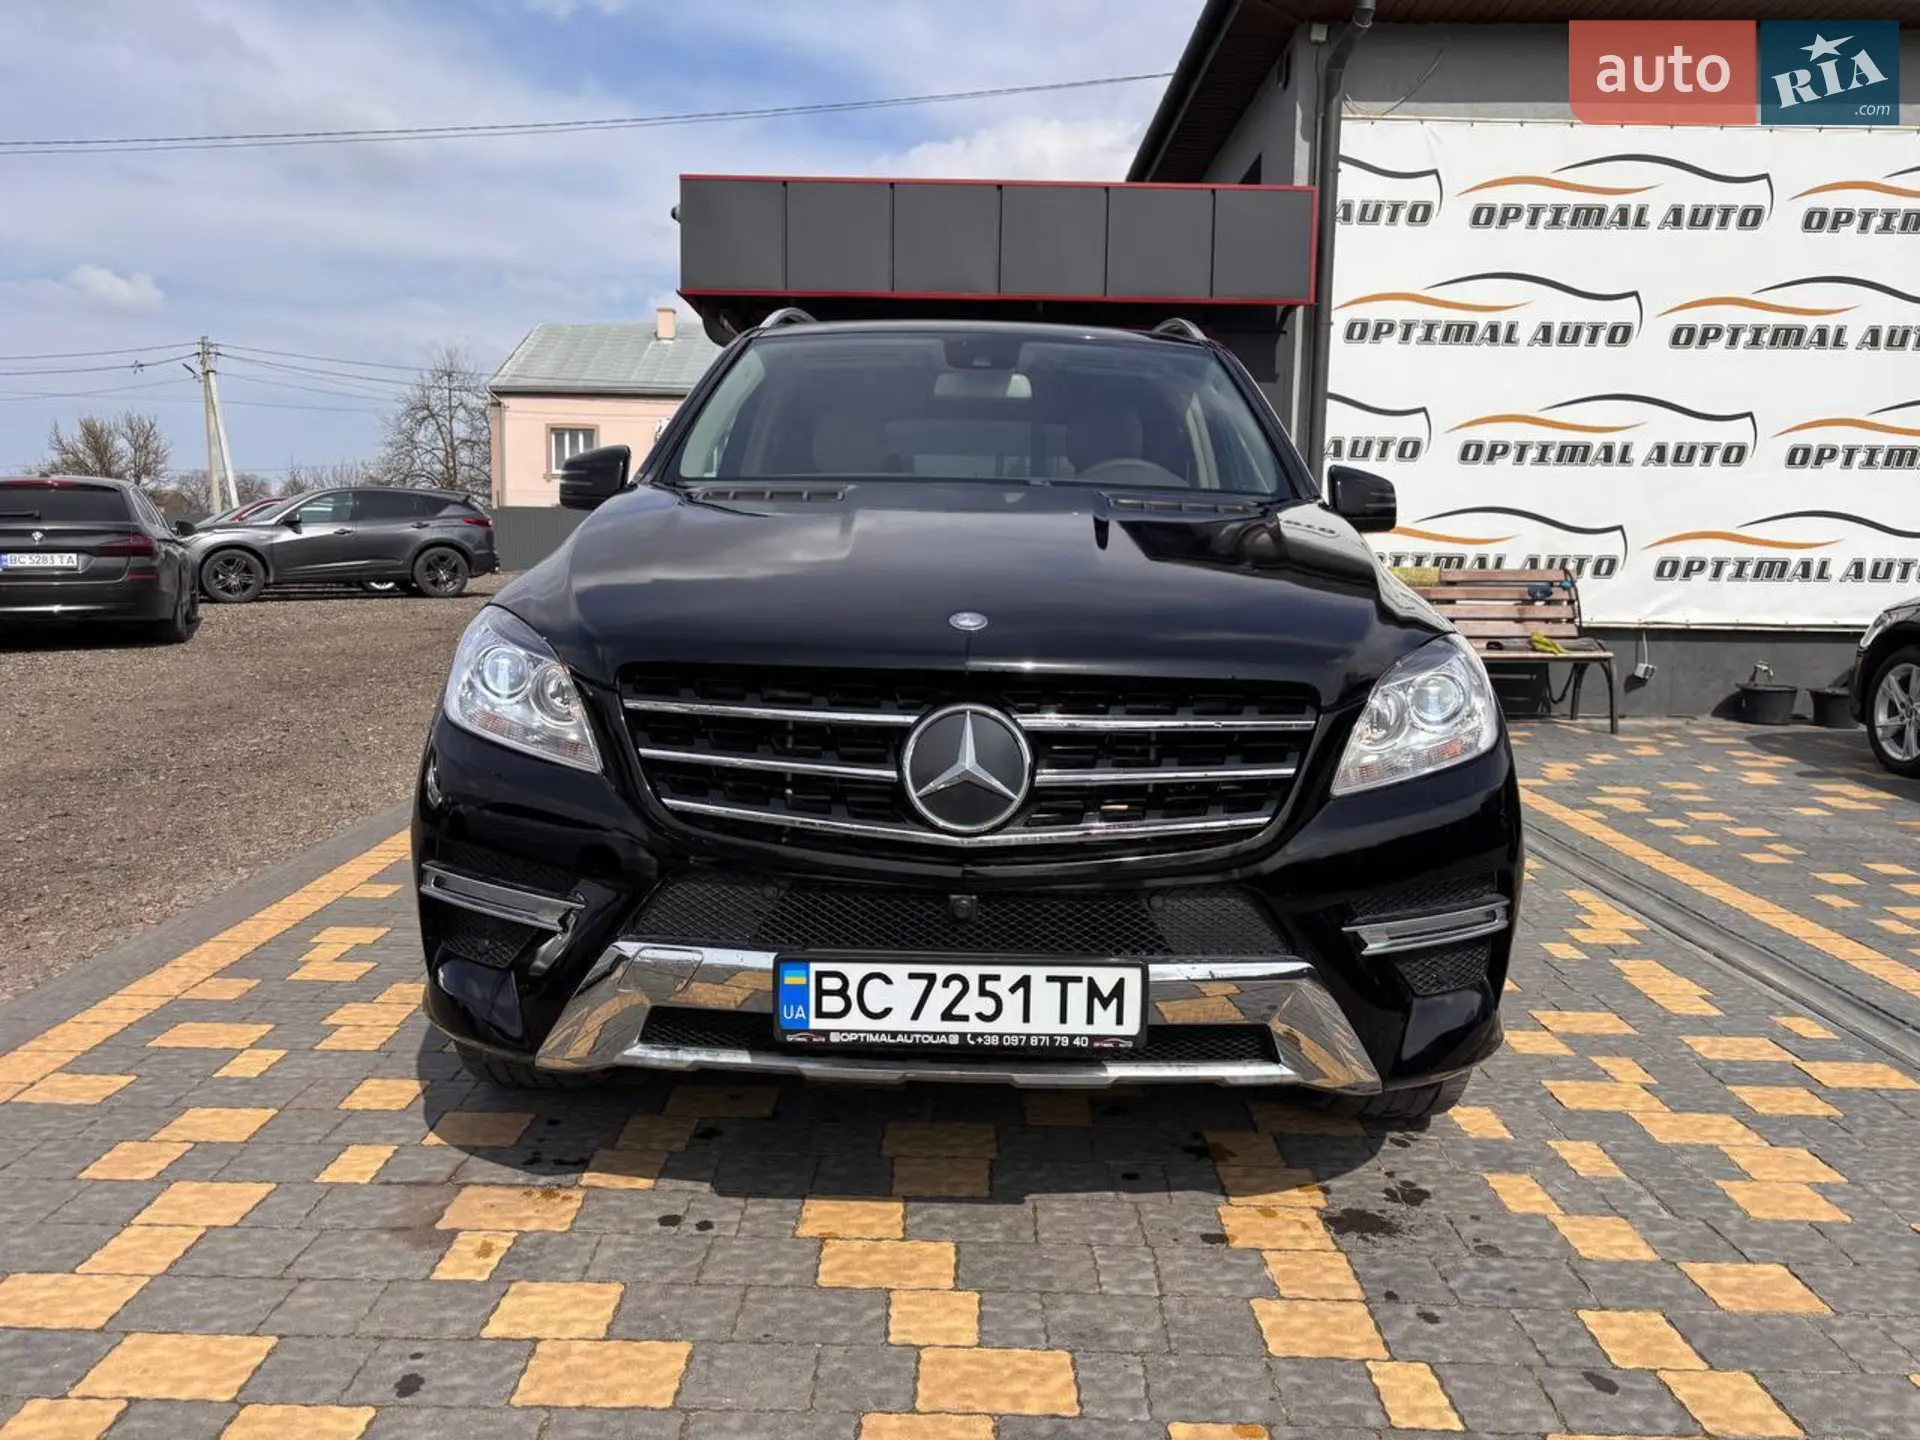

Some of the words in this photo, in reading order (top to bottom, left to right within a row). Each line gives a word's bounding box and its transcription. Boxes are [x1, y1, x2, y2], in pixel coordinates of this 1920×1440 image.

[1335, 200, 1434, 227] AUTO
[1469, 203, 1650, 230] OPTIMAL
[1657, 204, 1765, 230] AUTO
[1343, 319, 1520, 346] OPTIMAL
[1527, 322, 1633, 348] AUTO
[1669, 324, 1848, 350] OPTIMAL
[1324, 437, 1423, 462] AUTO
[1458, 440, 1634, 466] OPTIMAL
[1642, 442, 1748, 468] AUTO
[1785, 444, 1920, 470] OPTIM
[1654, 557, 1832, 582] OPTIMAL
[1839, 558, 1920, 583] AUT
[815, 971, 894, 1020] BC
[908, 973, 1032, 1024] 7251
[1046, 976, 1125, 1026] TM
[783, 1004, 807, 1020] UA
[976, 1034, 1000, 1046] +38
[1003, 1035, 1026, 1046] 097
[1030, 1036, 1050, 1046] 871
[1054, 1036, 1069, 1047] 79
[1073, 1036, 1089, 1047] 40
